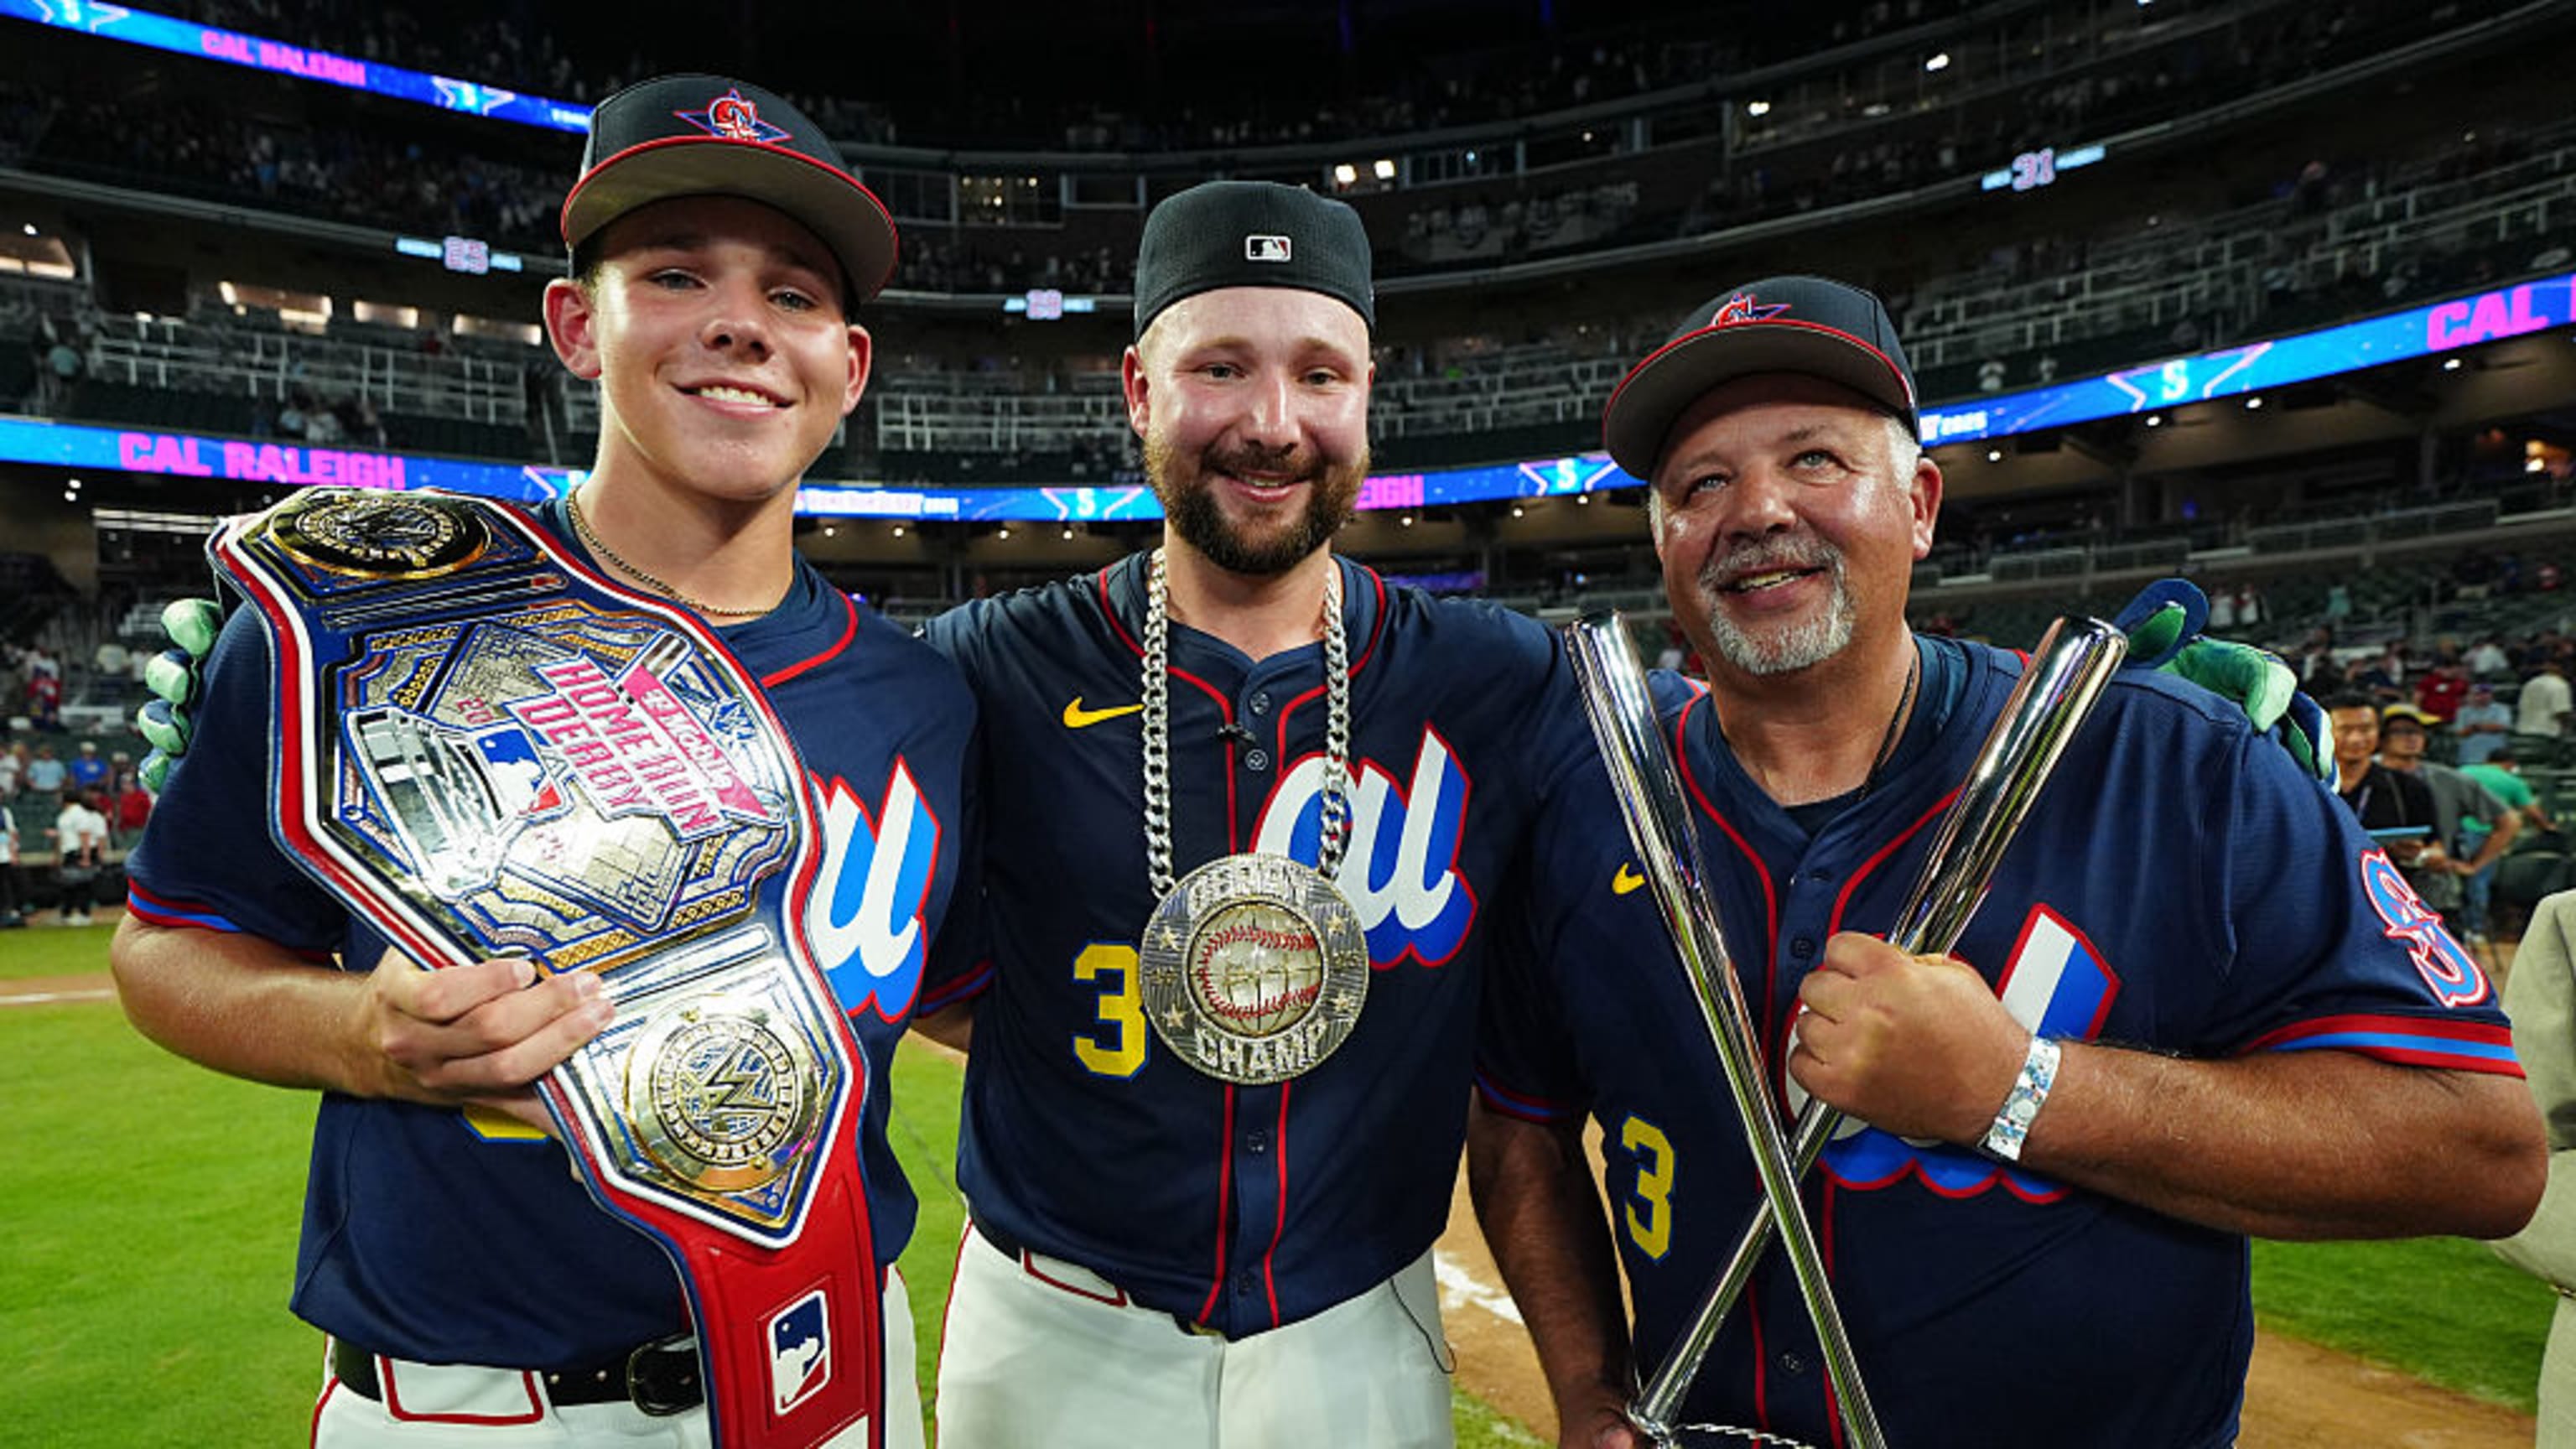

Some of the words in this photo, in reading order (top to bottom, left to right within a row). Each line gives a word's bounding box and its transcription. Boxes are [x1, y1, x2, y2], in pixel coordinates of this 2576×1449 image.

[203, 30, 254, 61] CAL
[261, 42, 366, 86] RALEIGH
[2427, 285, 2549, 351] CAL
[2162, 360, 2188, 400] S
[119, 432, 212, 476] CAL
[223, 442, 406, 491] RALEIGH
[1557, 459, 1576, 489] S
[517, 699, 653, 808] DERBY
[543, 661, 661, 756] HOME
[633, 755, 719, 832] RUN
[1072, 943, 1149, 1081] 3
[1194, 1015, 1327, 1078] CHAMP
[1622, 1114, 1677, 1262] 3
